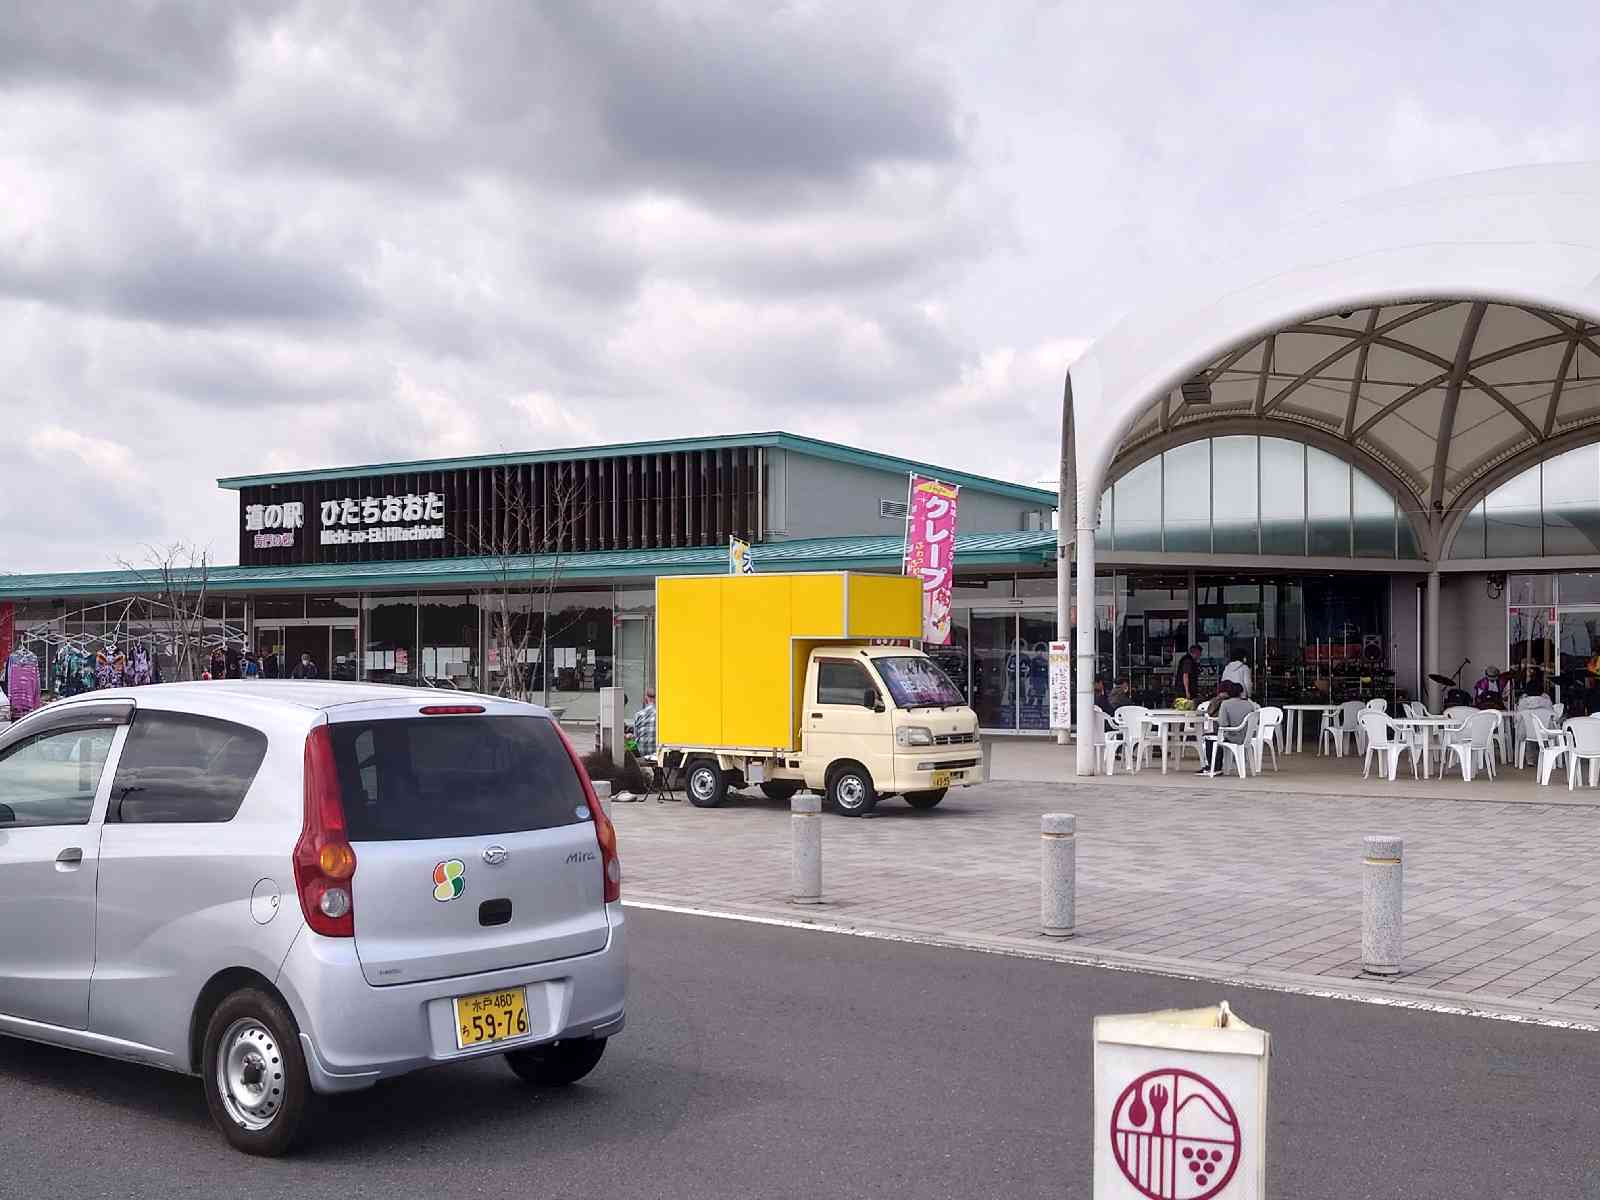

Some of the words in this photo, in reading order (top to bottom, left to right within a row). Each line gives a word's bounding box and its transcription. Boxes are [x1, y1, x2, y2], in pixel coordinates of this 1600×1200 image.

[246, 502, 304, 530] 道の駅
[321, 492, 444, 525] ひたちおおた
[920, 496, 949, 590] クレープ
[566, 851, 596, 864] Mira
[473, 1008, 526, 1040] 59-76
